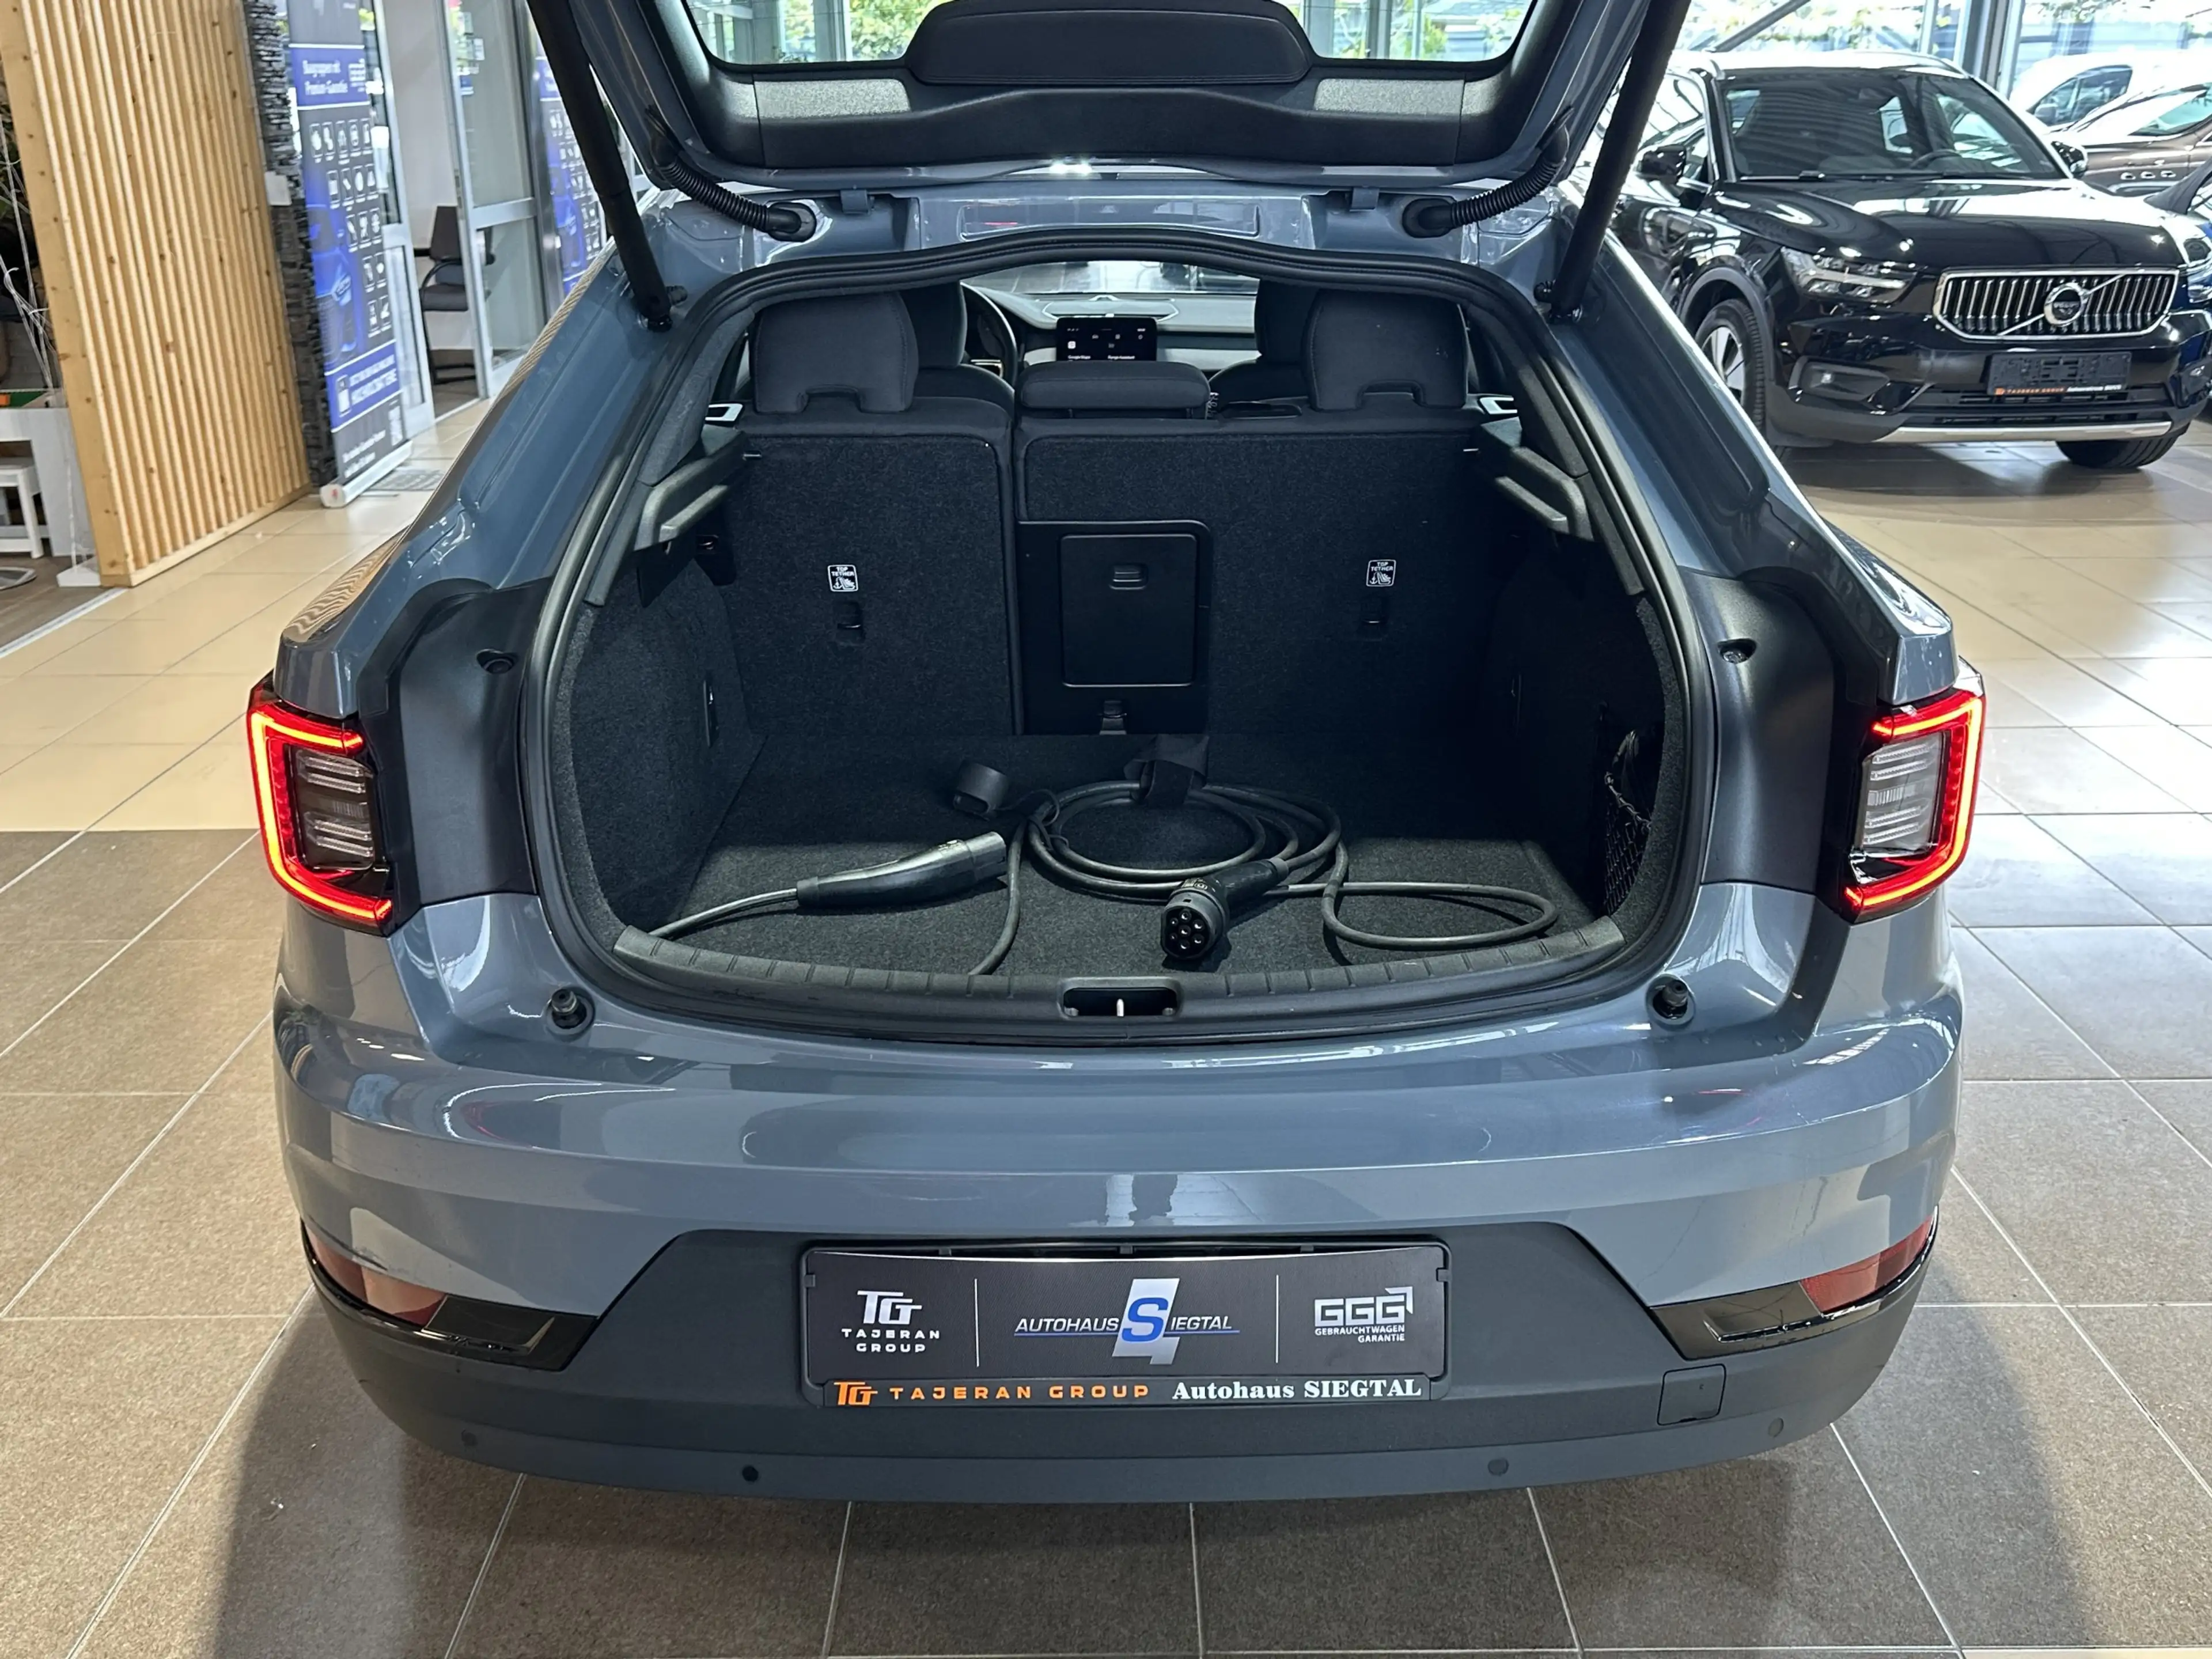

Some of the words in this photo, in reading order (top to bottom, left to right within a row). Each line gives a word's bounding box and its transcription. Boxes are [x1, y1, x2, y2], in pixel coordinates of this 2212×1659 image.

[1314, 1294, 1406, 1327] GGG
[1014, 1317, 1120, 1332] AUTOHAUS
[841, 1328, 940, 1339] TAJERAN
[1315, 1325, 1405, 1336] GEBRAUCHTWAGEN
[1357, 1334, 1405, 1343] GARANTIE
[856, 1343, 926, 1353] GROUP
[889, 1386, 1031, 1400] TAJERAN
[1049, 1385, 1149, 1399] GROUP
[1172, 1382, 1295, 1400] Autohaus
[1304, 1378, 1422, 1399] SIEGTAL
